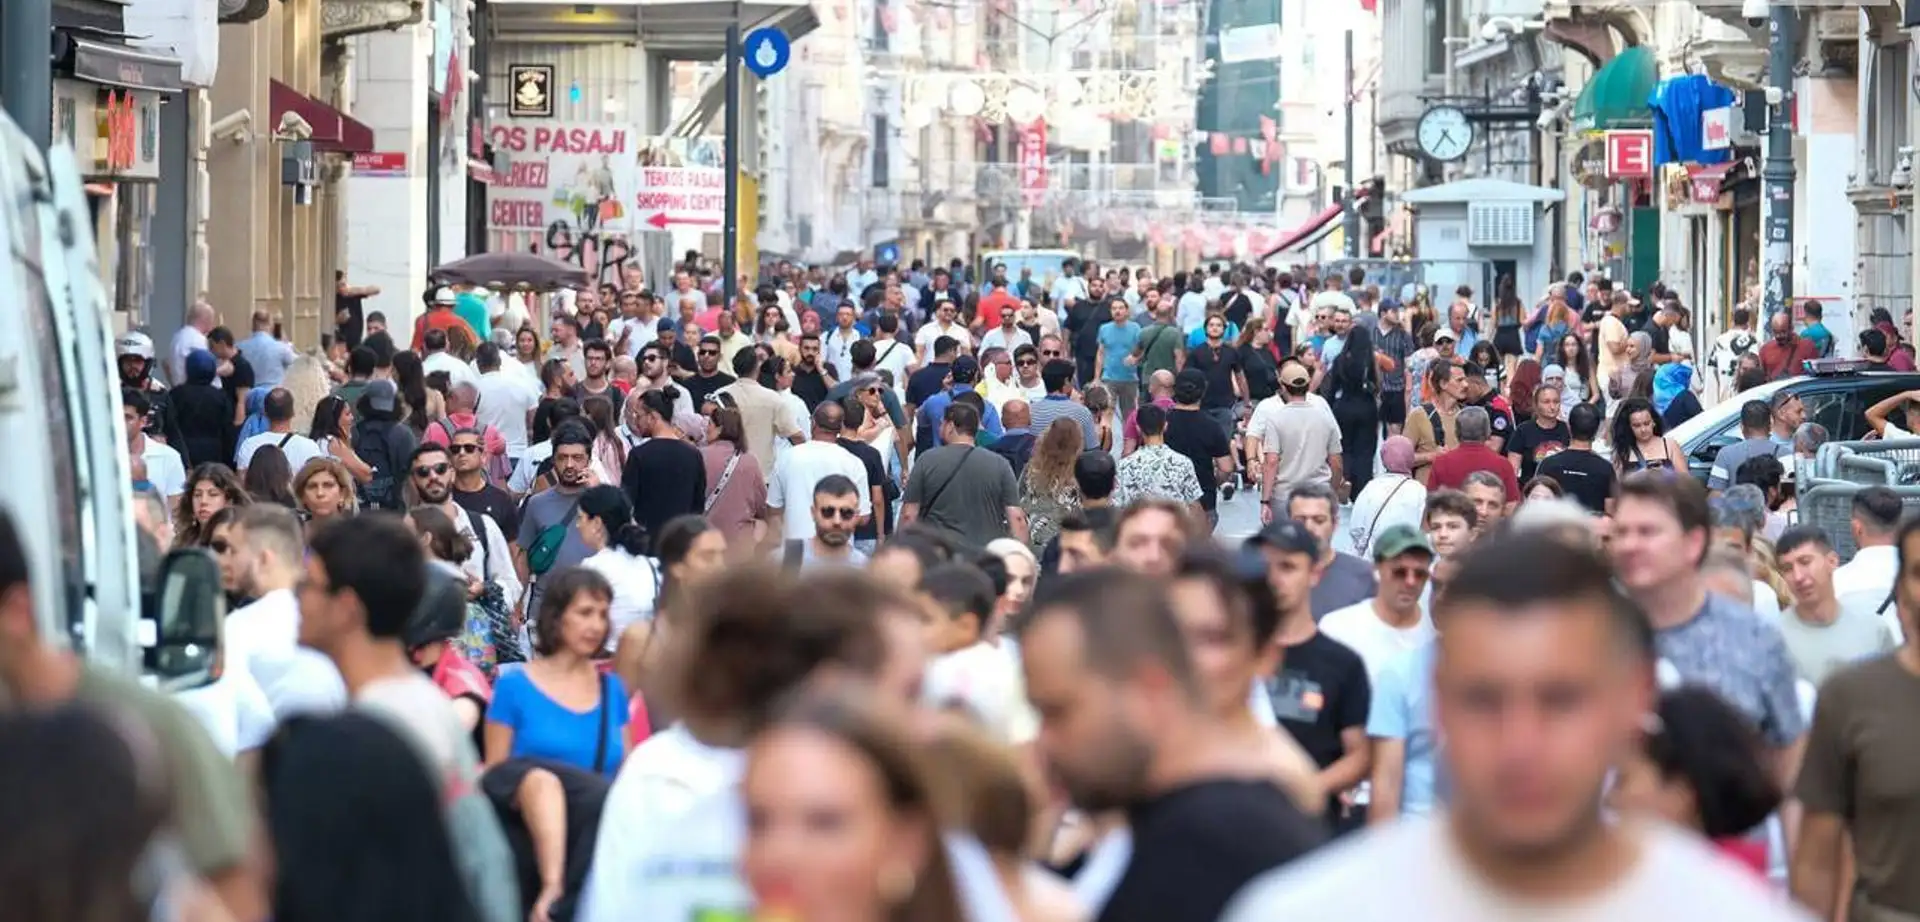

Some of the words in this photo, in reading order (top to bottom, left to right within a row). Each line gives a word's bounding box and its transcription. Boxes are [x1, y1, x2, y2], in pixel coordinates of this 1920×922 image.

[535, 127, 624, 154] PASAJI
[1617, 135, 1643, 173] E
[644, 170, 683, 187] TERKOS
[492, 200, 542, 226] CENTER
[637, 192, 687, 210] SHOPPING
